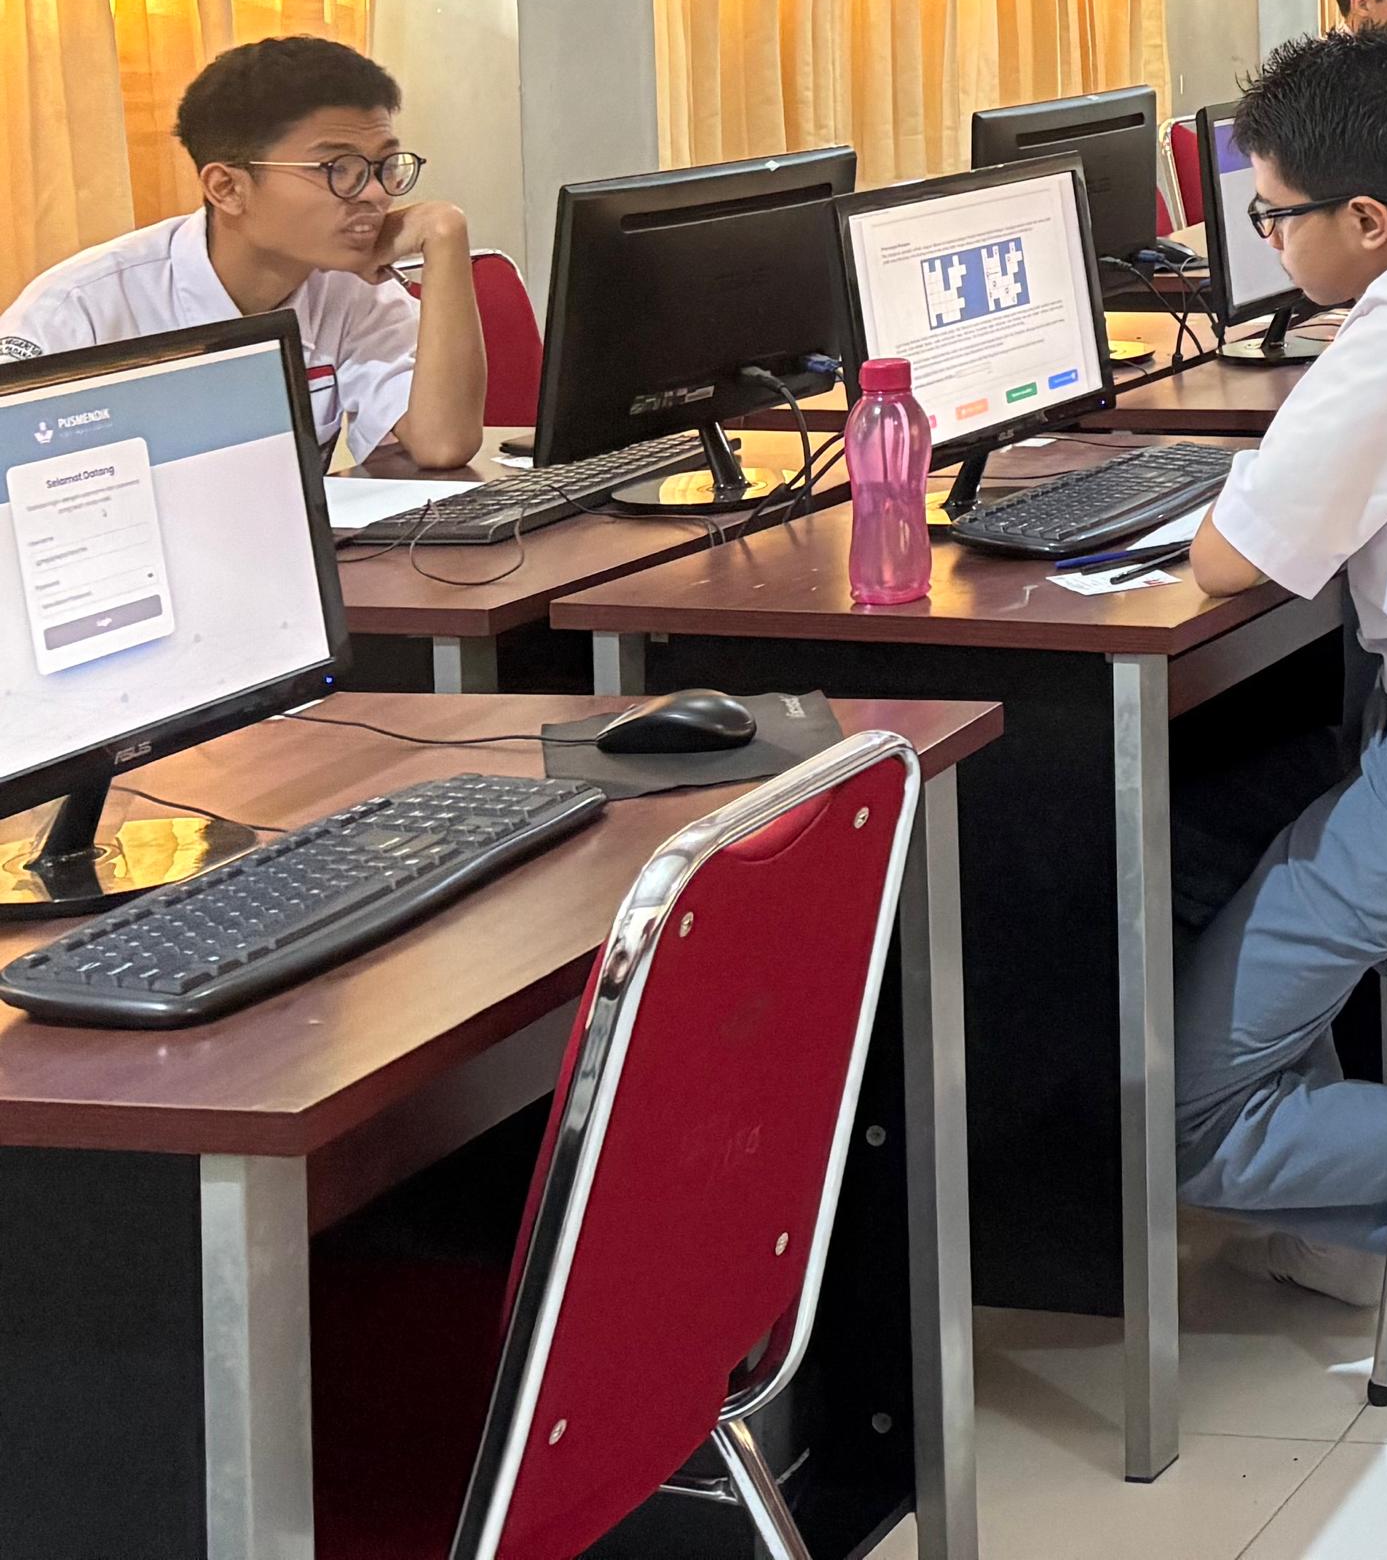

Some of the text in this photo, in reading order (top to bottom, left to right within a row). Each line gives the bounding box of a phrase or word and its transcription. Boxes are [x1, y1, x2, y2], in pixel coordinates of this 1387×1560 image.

[57, 408, 111, 428] PUSMENDIK
[46, 465, 115, 489] Selamat Datang
[114, 740, 152, 765] ASUS
